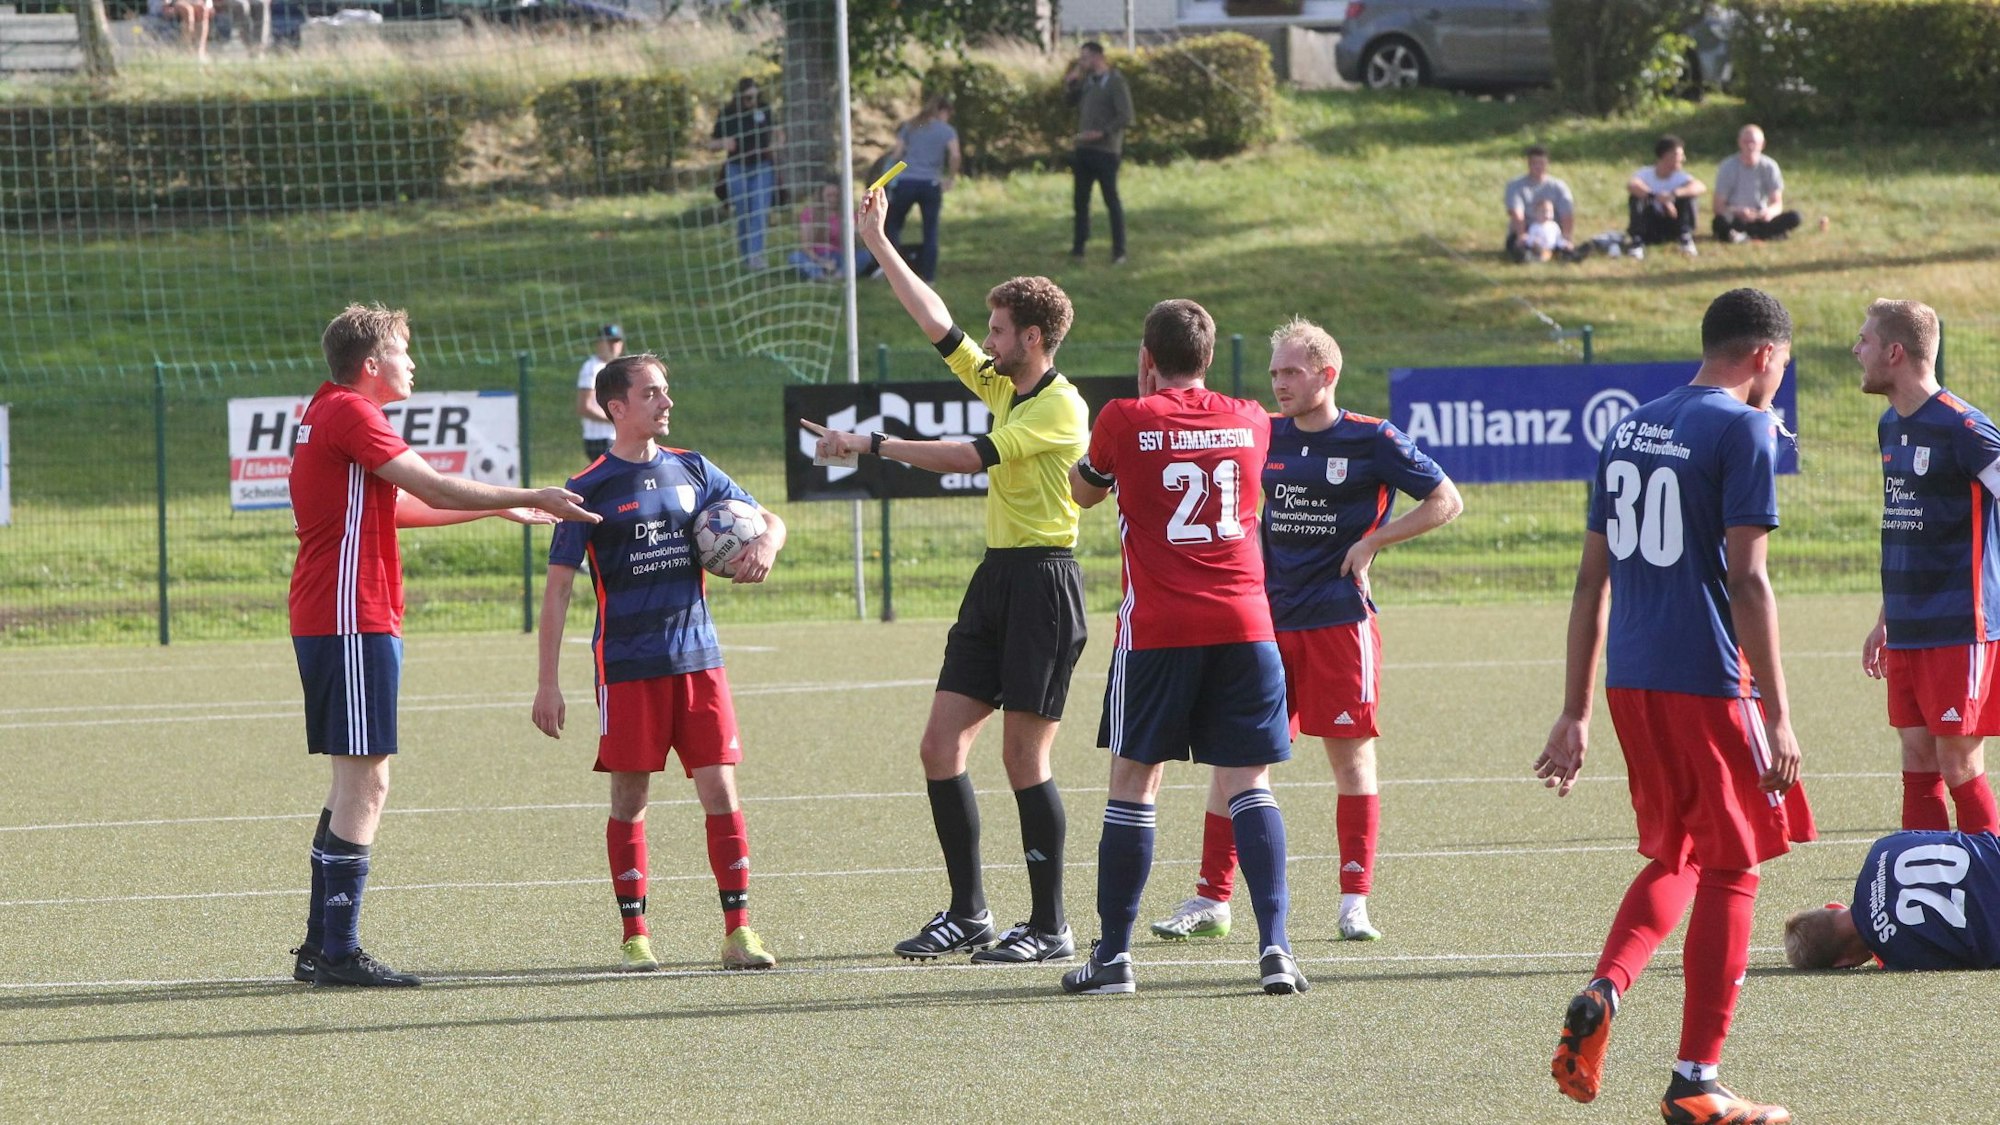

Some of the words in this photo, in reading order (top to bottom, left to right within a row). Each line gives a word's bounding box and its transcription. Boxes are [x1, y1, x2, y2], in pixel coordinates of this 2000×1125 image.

[1406, 401, 1573, 446] Allianz
[1139, 431, 1164, 451] SSV
[1168, 428, 1255, 450] LOMMERSUM
[1301, 446, 1309, 457] 8
[644, 478, 657, 490] 21
[1275, 483, 1308, 499] Dieter
[617, 501, 639, 513] JAKO
[1162, 459, 1246, 545] 21
[1284, 493, 1309, 509] Klein
[1271, 509, 1337, 522] Mineralölhandel
[1606, 460, 1684, 567] 30
[635, 520, 667, 540] Dieter
[648, 529, 672, 547] Klein
[1271, 522, 1337, 535] 02447-917979-0
[1894, 844, 1970, 928] 20
[1870, 880, 1884, 919] Dahlem
[1872, 911, 1897, 943] SG
